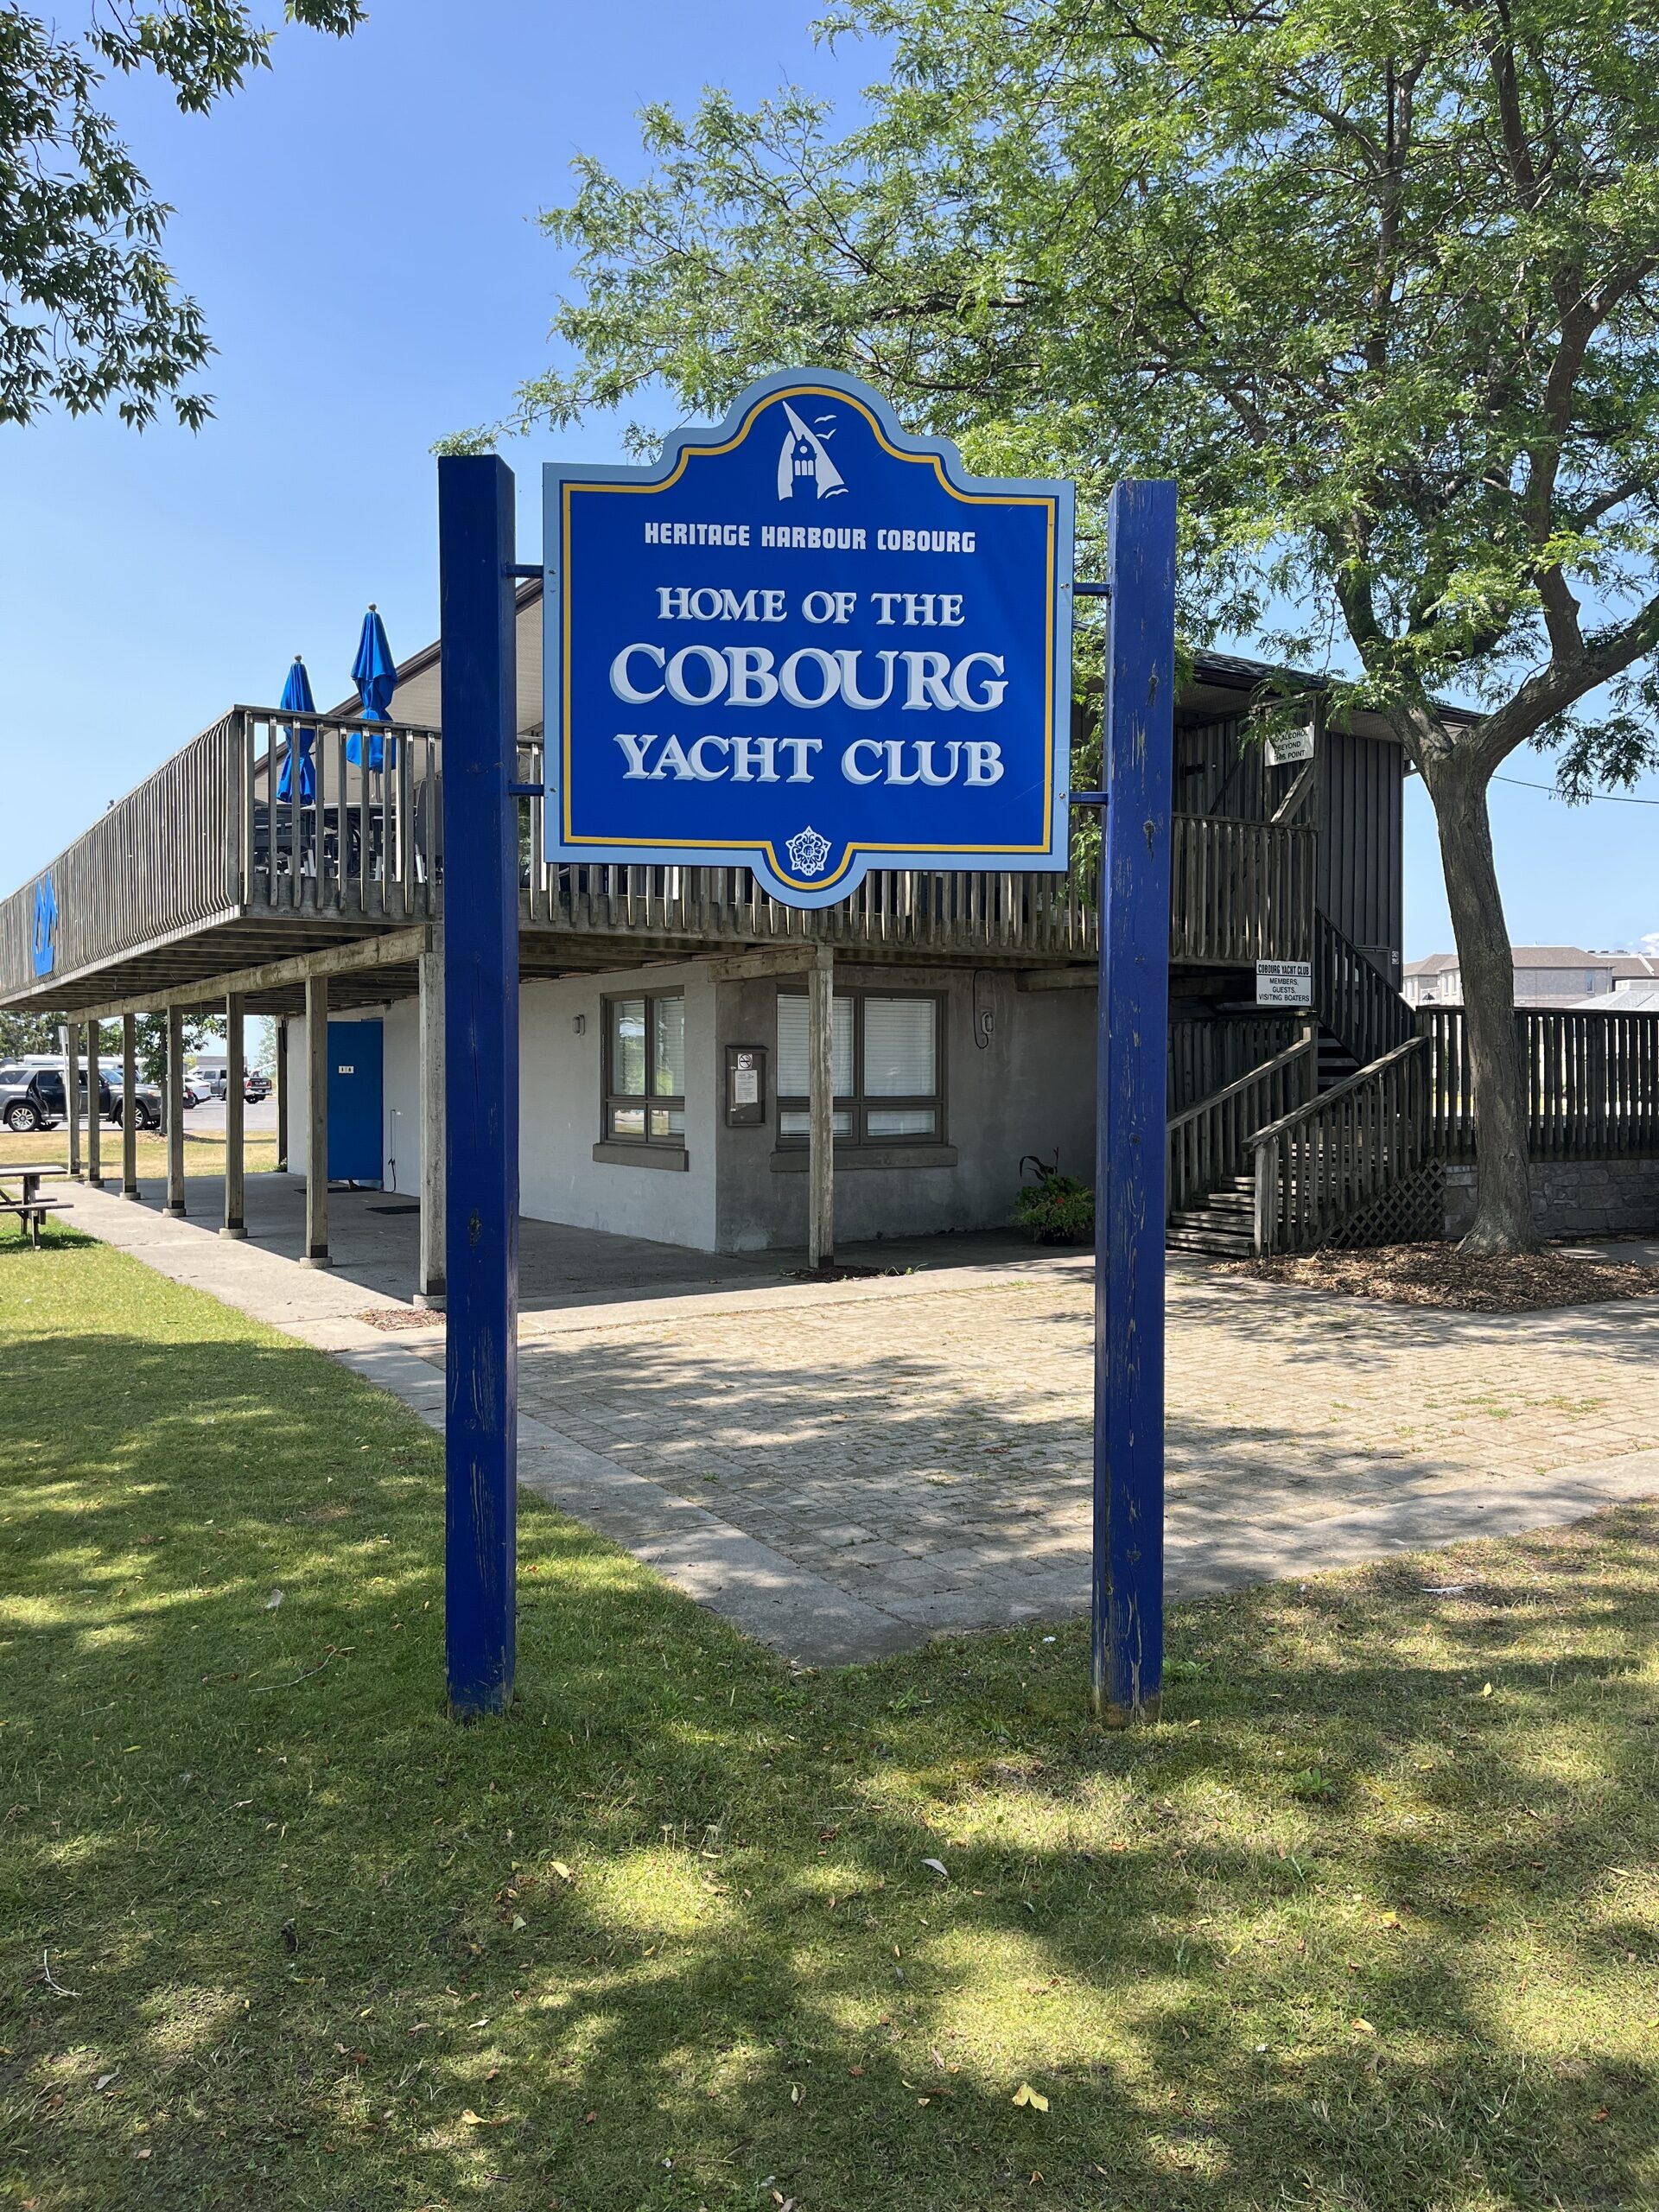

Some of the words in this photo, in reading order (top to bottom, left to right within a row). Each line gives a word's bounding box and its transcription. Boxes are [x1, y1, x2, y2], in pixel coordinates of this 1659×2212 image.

[645, 522, 750, 547] HERITAGE
[762, 525, 866, 550] HARBOUR
[878, 529, 976, 553] COBOURG
[656, 587, 787, 621] HOME
[802, 590, 856, 624] OF
[871, 593, 965, 626] THE
[609, 643, 1009, 712] COBOURG
[613, 734, 822, 783] YACHT
[842, 739, 1003, 786] CLUB
[1287, 750, 1305, 759] POINT
[1258, 964, 1280, 974] COBOURG
[1281, 965, 1296, 974] YACHT
[1297, 966, 1309, 975] CLUB
